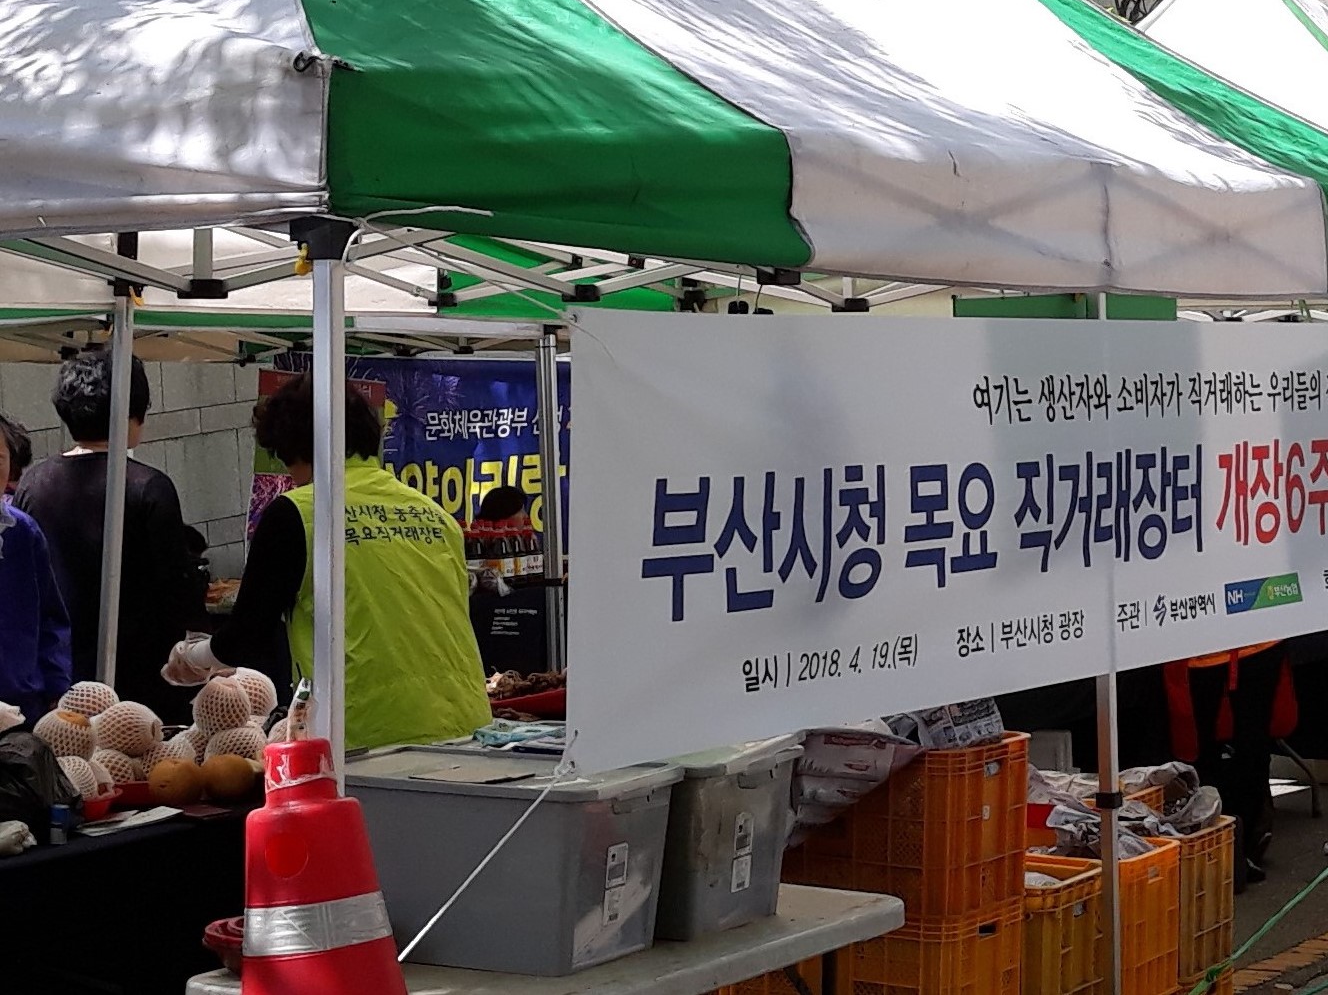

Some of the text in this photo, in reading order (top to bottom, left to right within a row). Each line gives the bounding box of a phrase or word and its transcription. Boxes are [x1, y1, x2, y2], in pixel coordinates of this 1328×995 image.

[973, 376, 1033, 425] 여기는
[1038, 374, 1111, 422] 생산자와
[1117, 371, 1183, 419] 소비자가
[1188, 370, 1263, 416] 직거래하는
[1267, 369, 1321, 412] 우리들의
[425, 407, 528, 441] 문화체육관광부
[345, 505, 387, 523] 산시청
[641, 464, 887, 622] 부산시청
[904, 462, 998, 589] 목요
[1014, 443, 1203, 572] 직거래장터
[1227, 589, 1244, 605] NH
[742, 592, 1216, 693] 일시 2018. 4. 19.(목) 장소 부산시청 광장 주관 부산광역시
